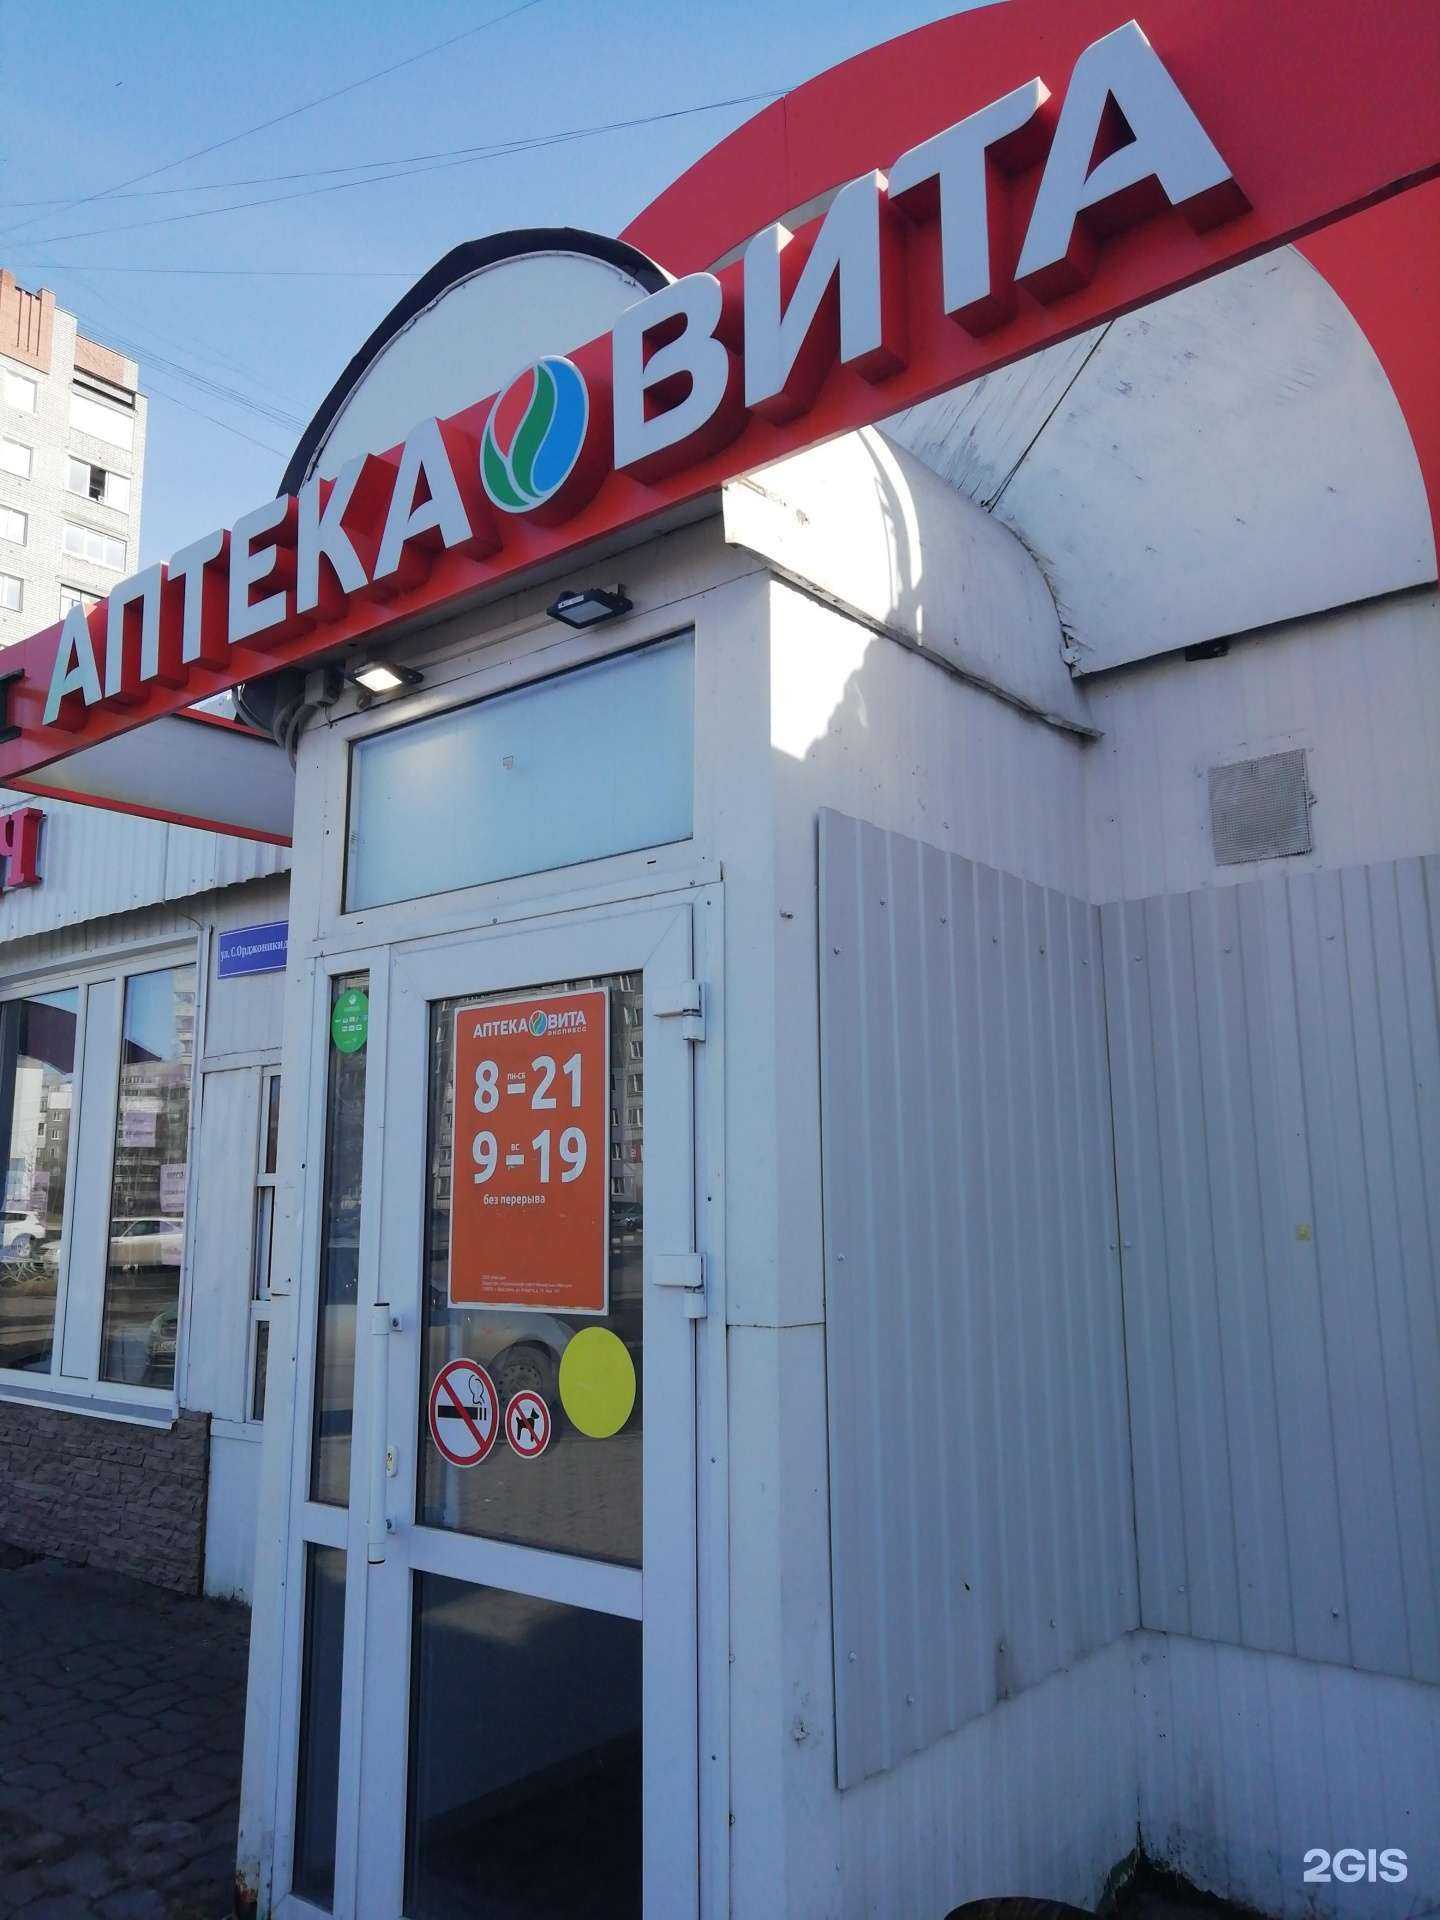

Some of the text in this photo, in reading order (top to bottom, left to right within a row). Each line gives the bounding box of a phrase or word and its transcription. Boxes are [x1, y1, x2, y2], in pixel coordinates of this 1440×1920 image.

[42, 19, 1234, 726] АПТЕКА ВИТА
[473, 1010, 587, 1039] АПТЕКА ВИТА
[483, 1194, 545, 1206] без перерыва
